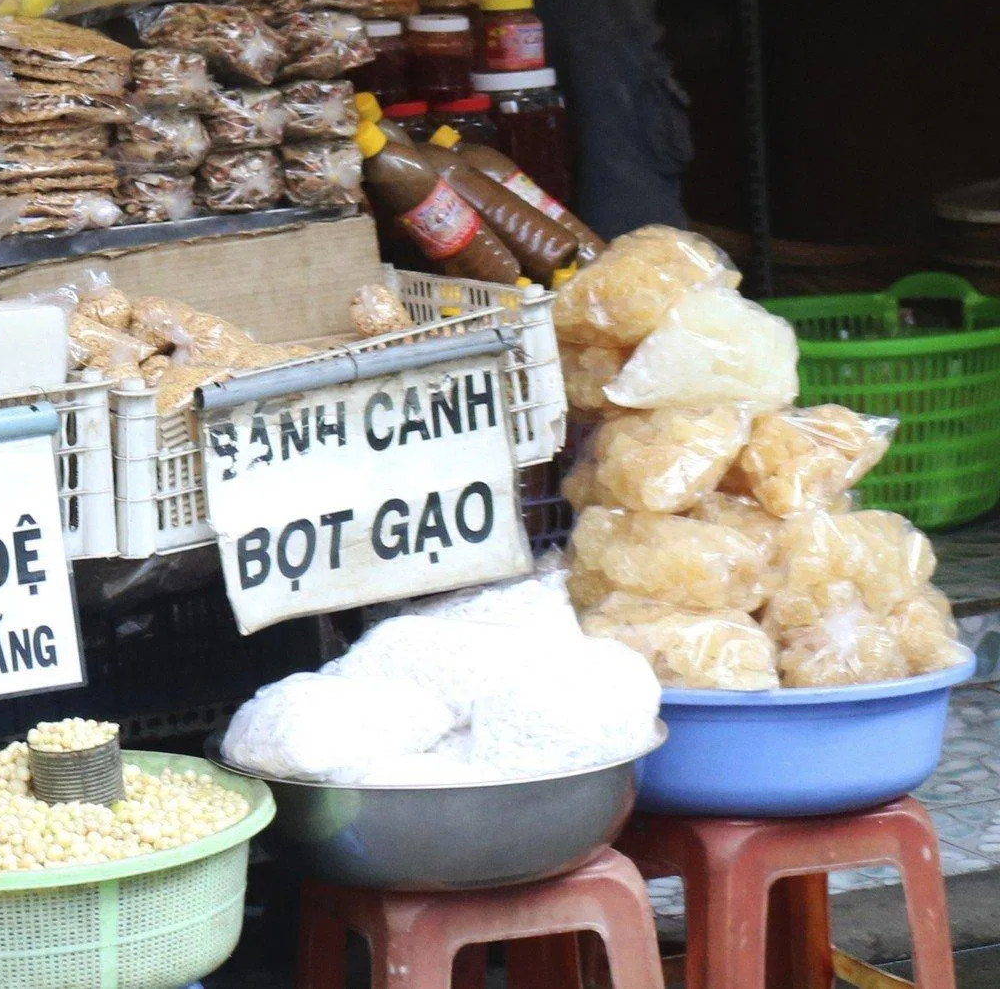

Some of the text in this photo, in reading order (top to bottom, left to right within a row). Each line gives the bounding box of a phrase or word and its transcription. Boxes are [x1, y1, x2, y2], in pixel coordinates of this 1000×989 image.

[363, 370, 497, 452] CANH
[236, 481, 494, 592] BỌT GẠO
